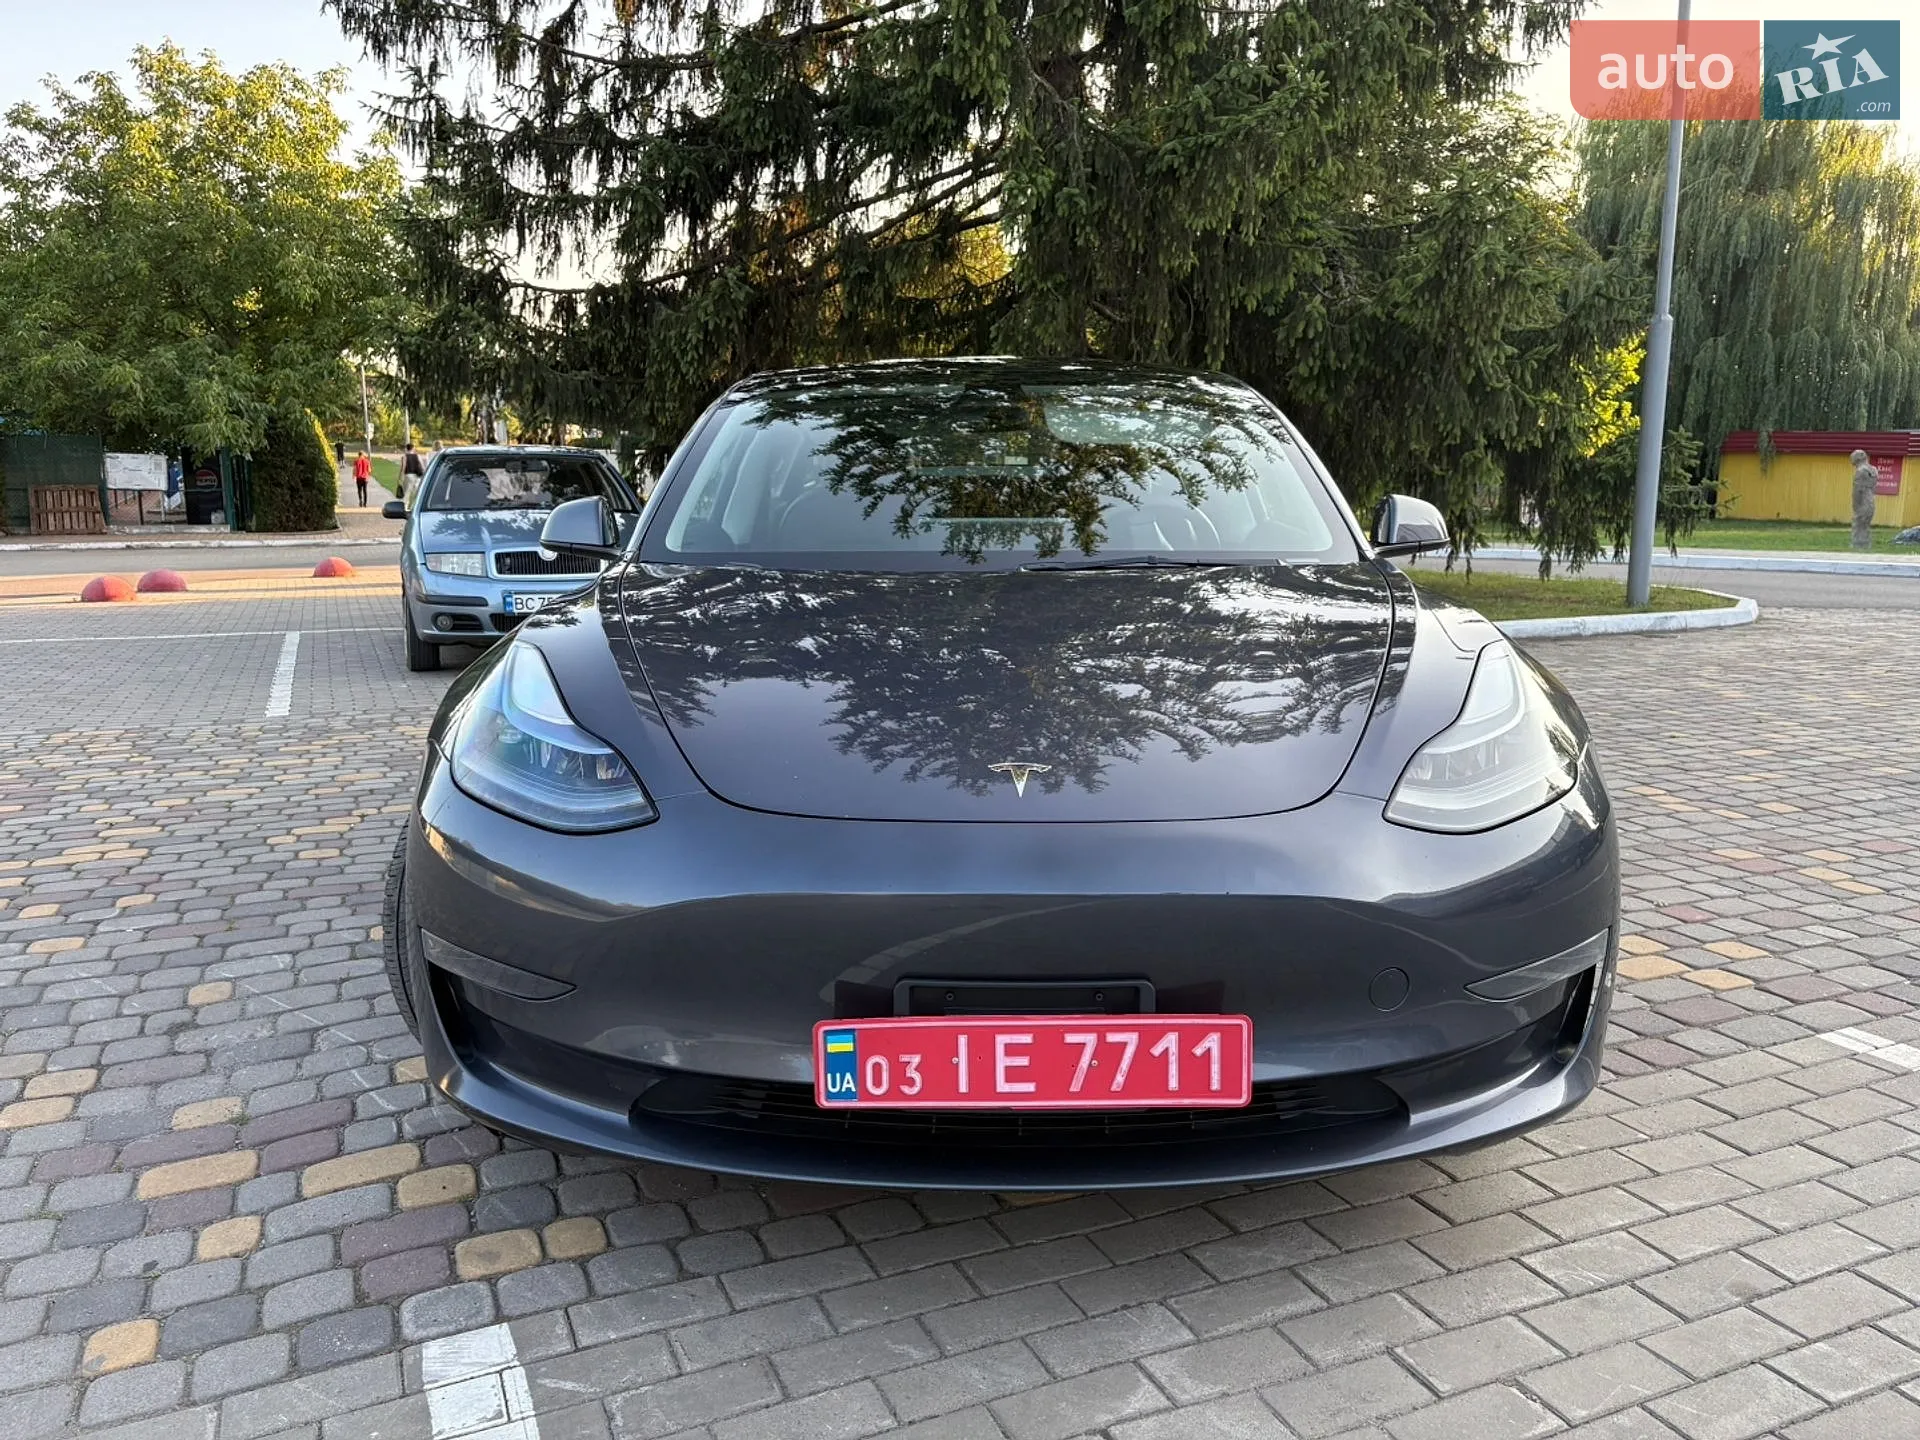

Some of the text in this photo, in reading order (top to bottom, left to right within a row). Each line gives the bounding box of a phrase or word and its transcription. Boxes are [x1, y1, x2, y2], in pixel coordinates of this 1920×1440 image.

[514, 597, 535, 611] BC
[827, 1073, 856, 1093] UA
[865, 1054, 923, 1096] 03
[1063, 1031, 1222, 1093] 7711
